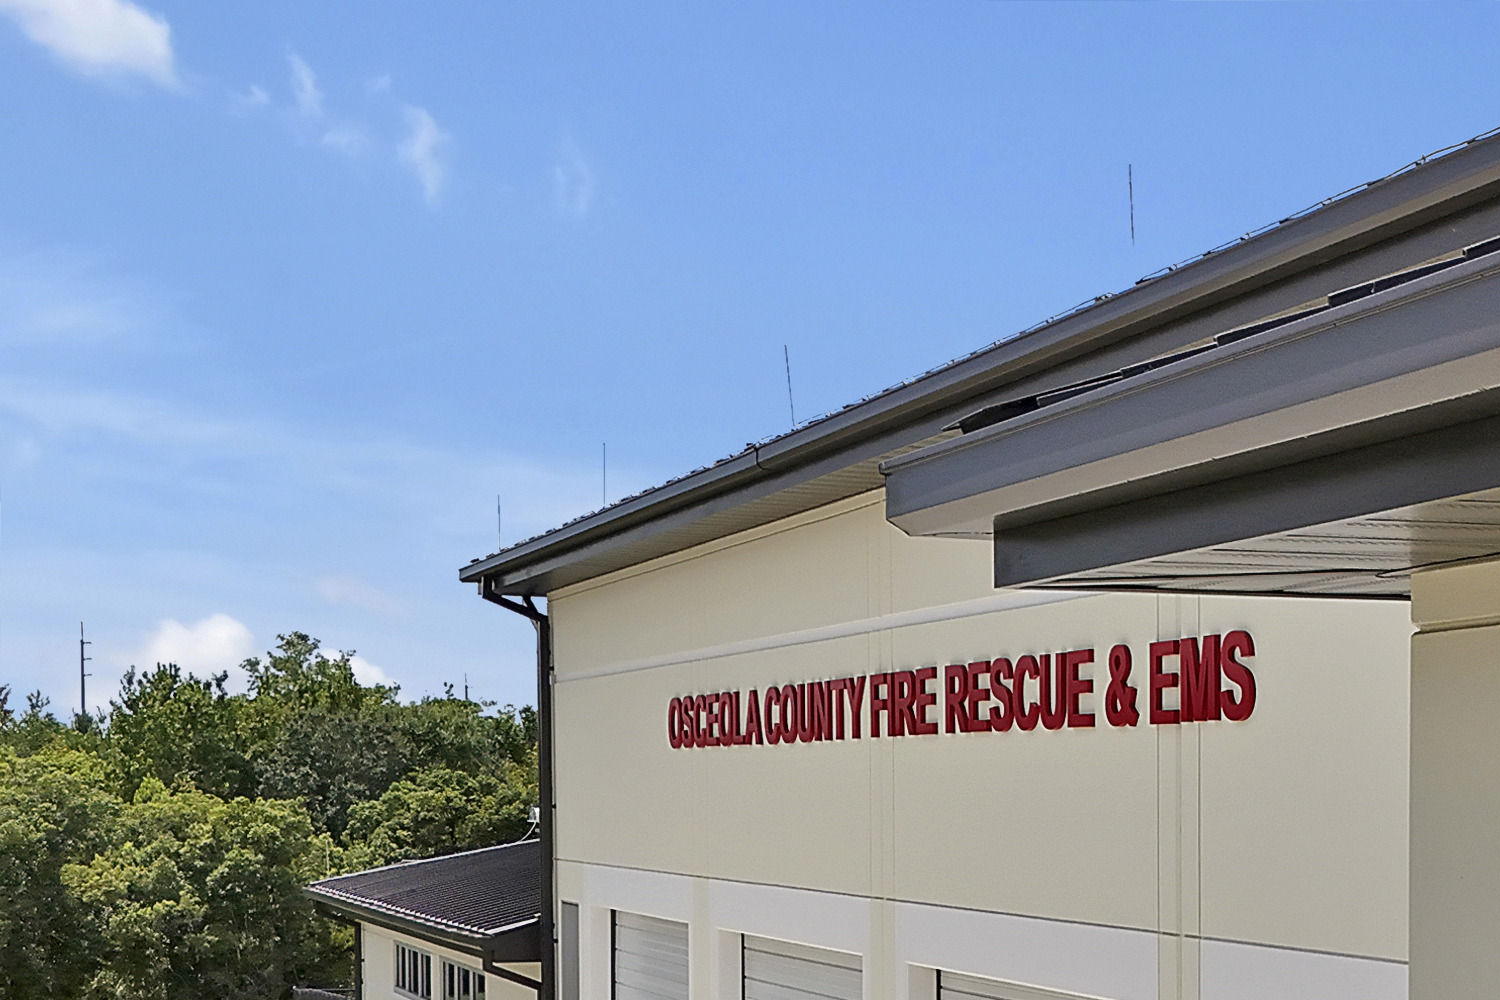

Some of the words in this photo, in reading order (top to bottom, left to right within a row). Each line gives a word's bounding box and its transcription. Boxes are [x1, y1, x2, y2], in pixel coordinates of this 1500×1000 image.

[668, 689, 762, 749] OSCEOLA
[764, 676, 866, 744] COUNTY
[870, 666, 938, 738] FIRE
[944, 648, 1096, 734] RESCUE
[1105, 643, 1140, 728] &
[1149, 629, 1256, 726] EMS
